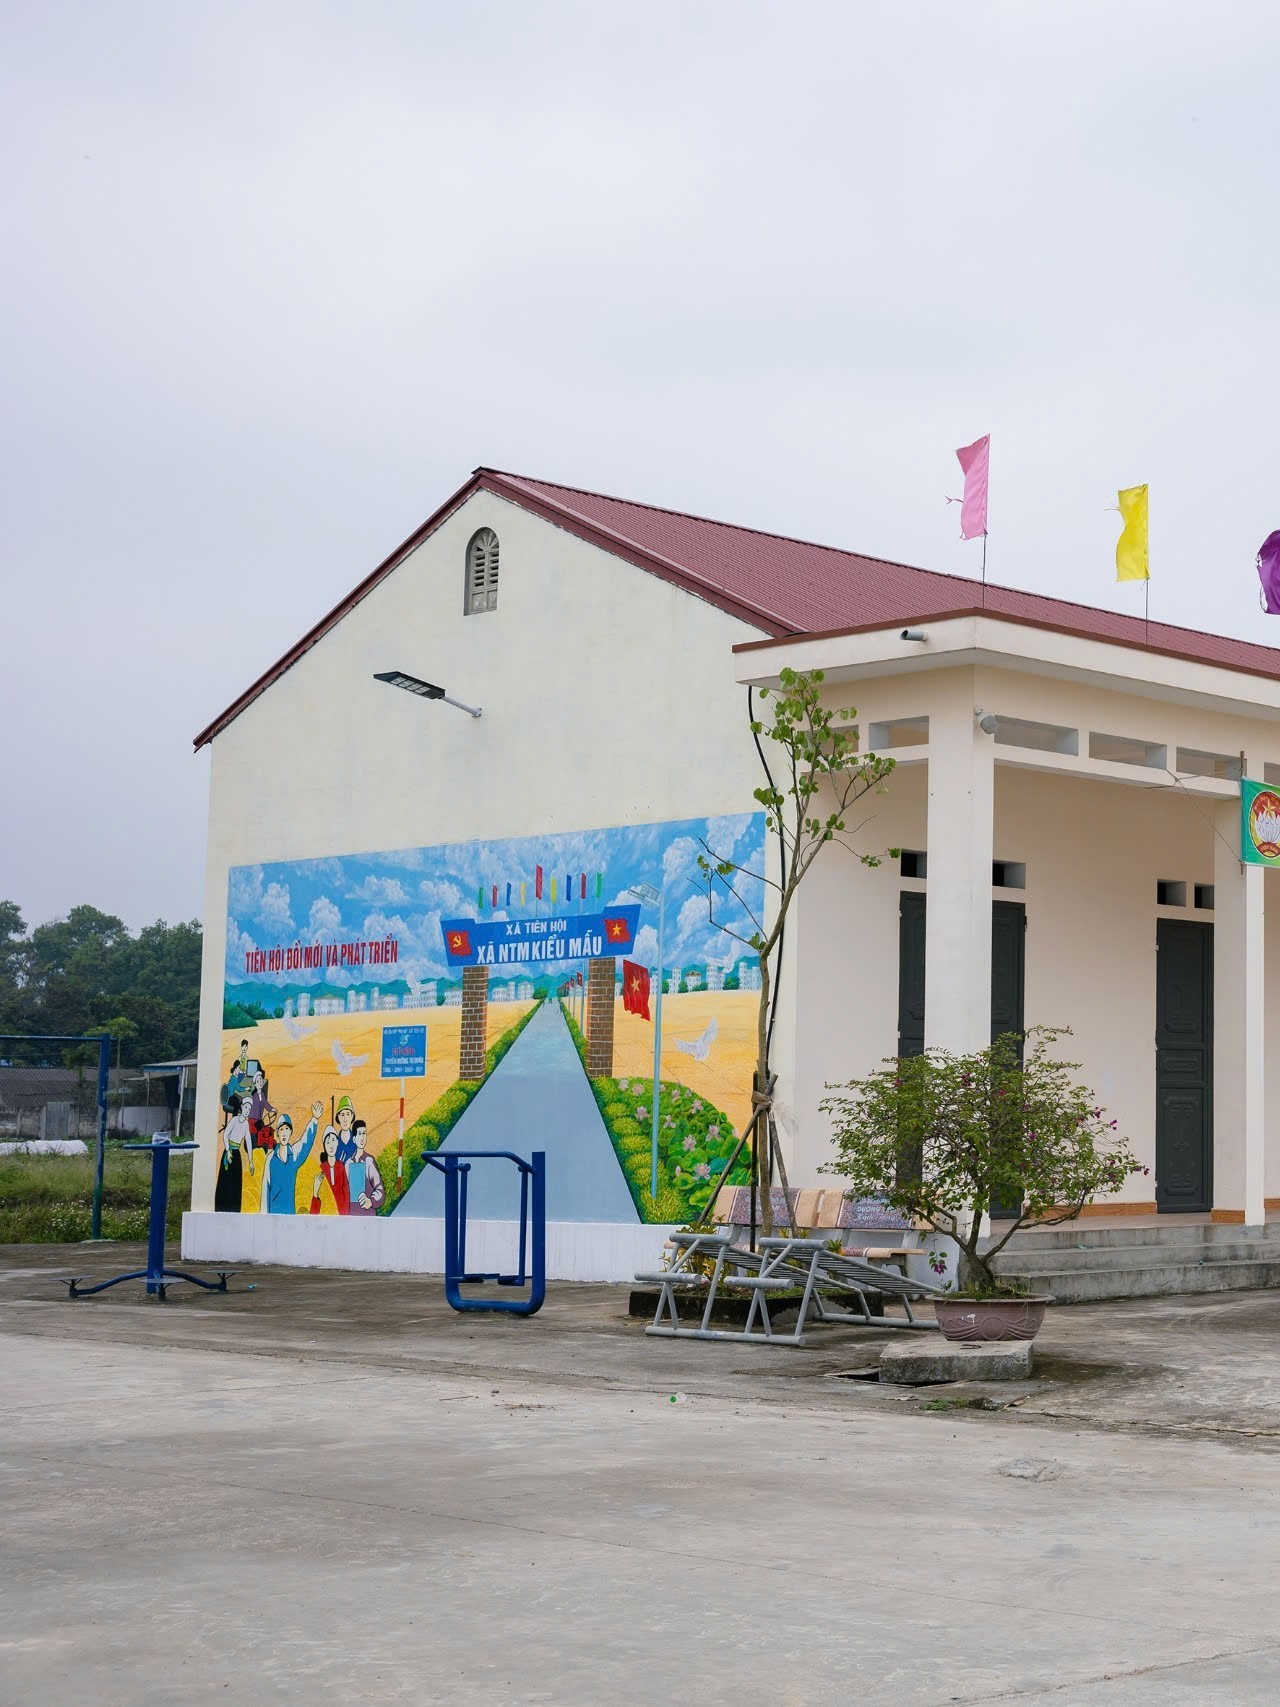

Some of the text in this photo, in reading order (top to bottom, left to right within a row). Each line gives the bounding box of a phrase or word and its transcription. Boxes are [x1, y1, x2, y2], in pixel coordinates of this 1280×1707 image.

[506, 921, 521, 936] XÃ
[525, 919, 547, 933] TIÊN
[245, 933, 398, 975] TIÊN HỘI ĐỔI MỚI VÀ PHÁT TRIỂN
[477, 929, 602, 965] XÃ NTM KIỂU MẪU
